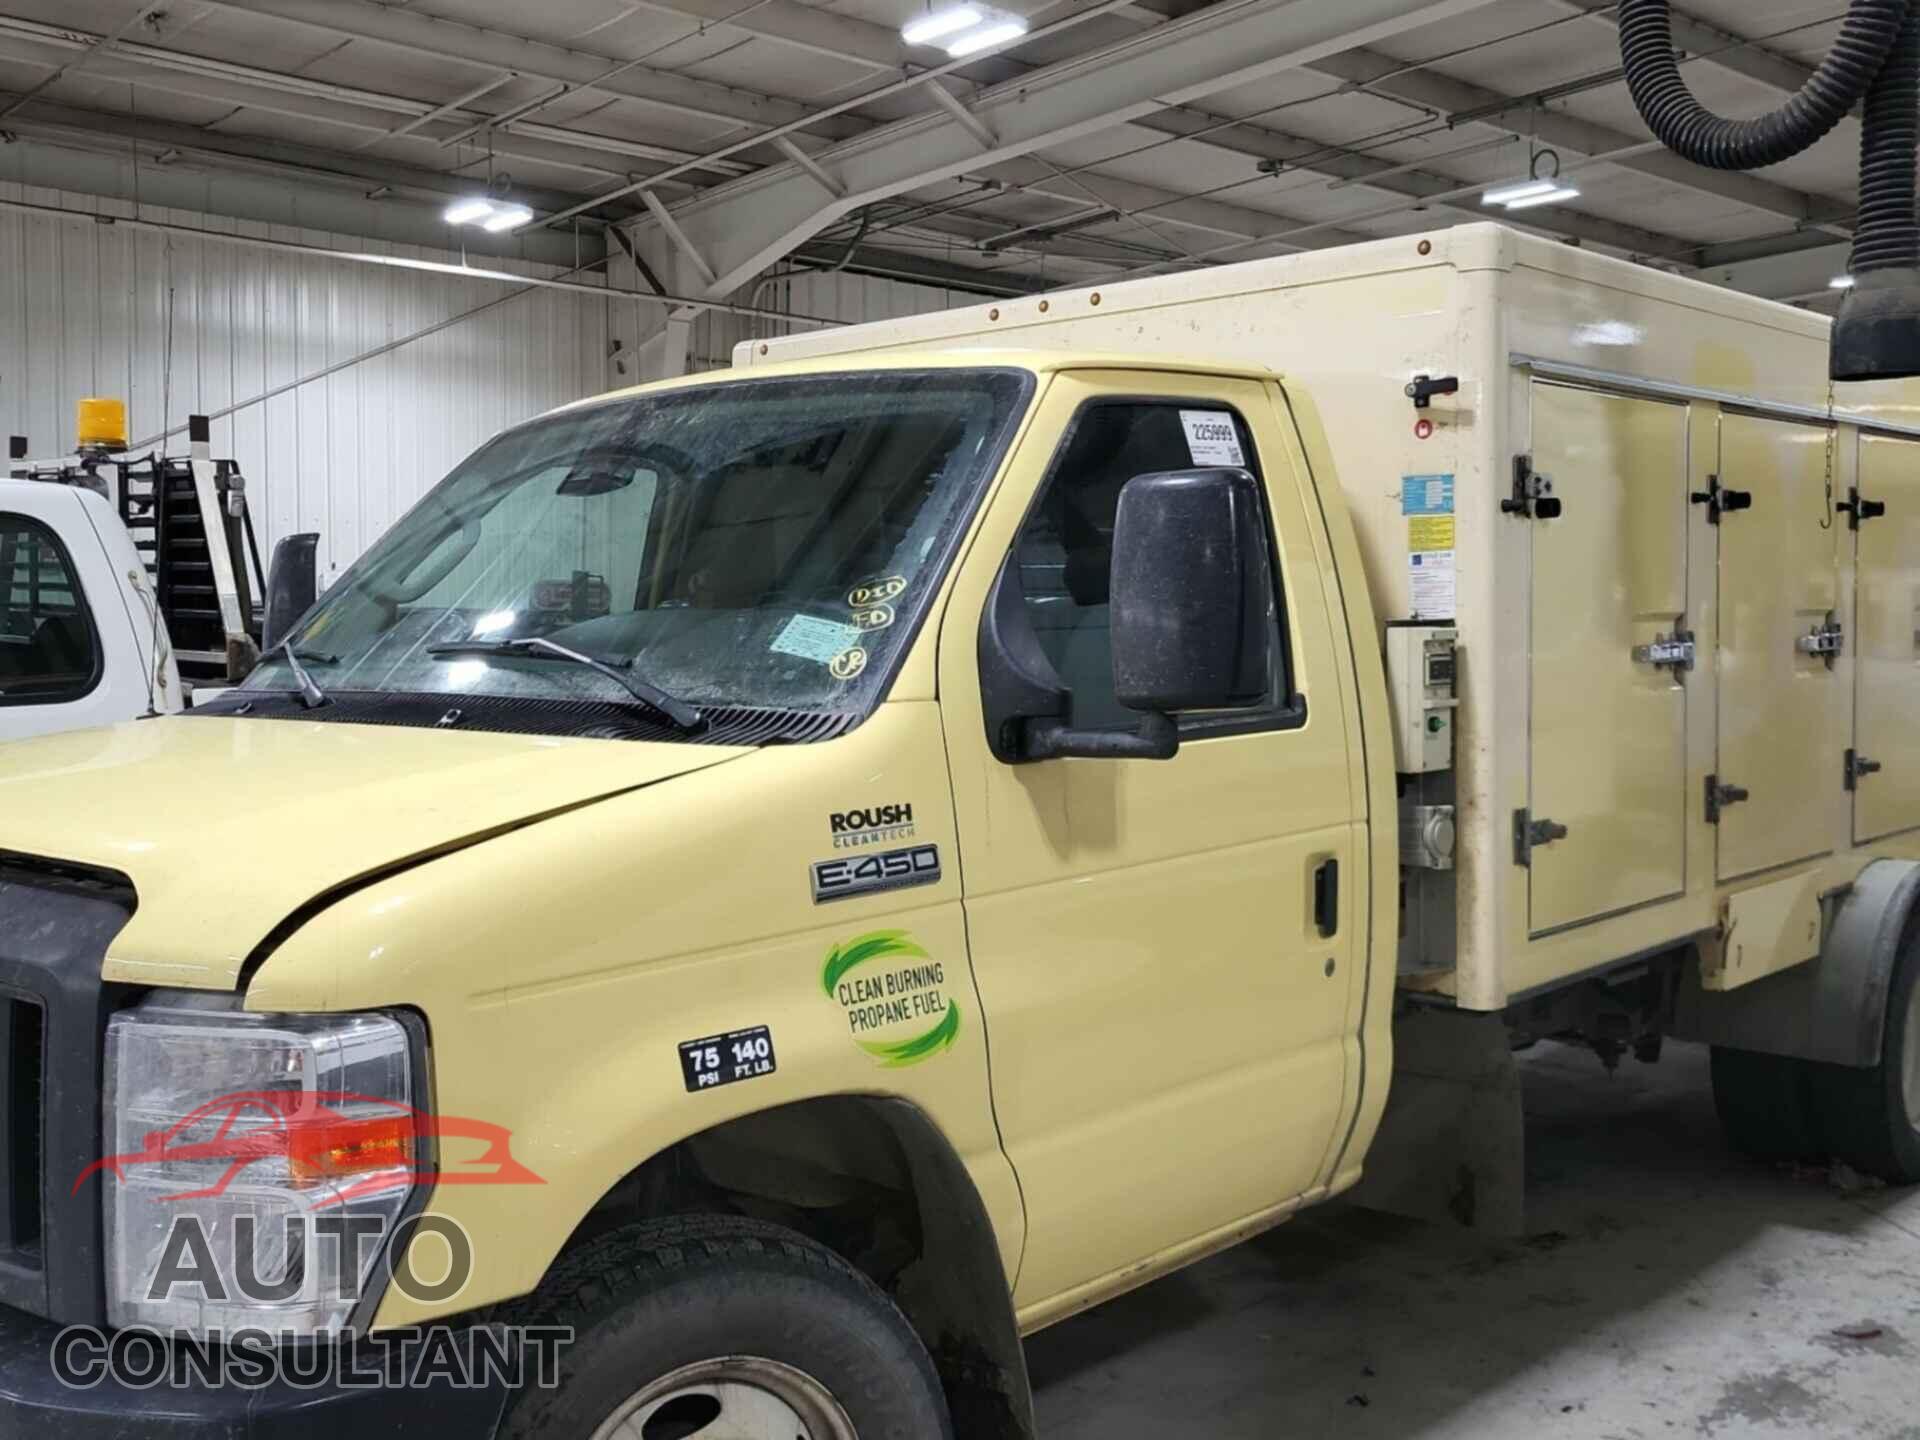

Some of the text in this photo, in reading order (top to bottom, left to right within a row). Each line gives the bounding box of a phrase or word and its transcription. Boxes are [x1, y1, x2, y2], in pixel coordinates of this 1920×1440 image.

[829, 803, 913, 833] ROUSH
[832, 827, 915, 848] CLEANTECH
[815, 847, 939, 888] E-450
[838, 962, 944, 1007] CLEAN BURNING
[848, 990, 946, 1033] PROPANE FUEL
[689, 1037, 769, 1072] 75 140
[698, 1059, 773, 1087] PSI FT. LB.
